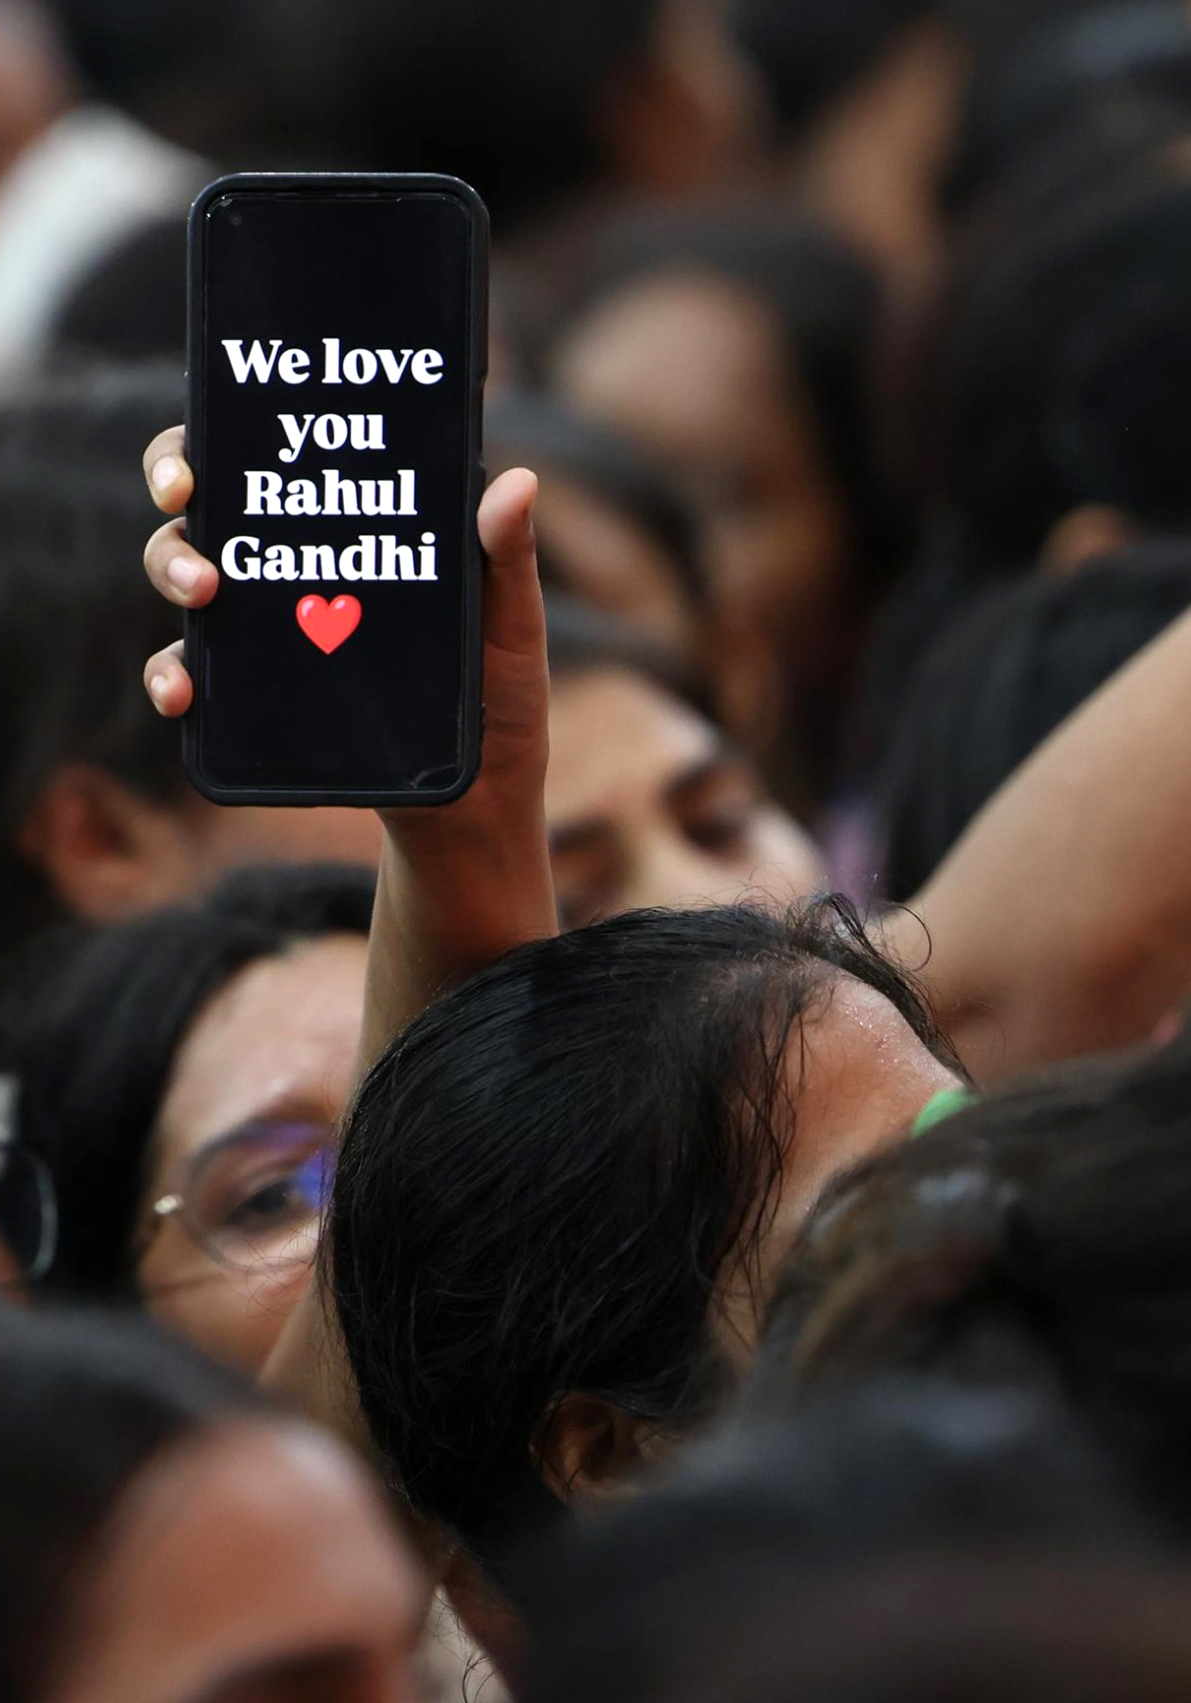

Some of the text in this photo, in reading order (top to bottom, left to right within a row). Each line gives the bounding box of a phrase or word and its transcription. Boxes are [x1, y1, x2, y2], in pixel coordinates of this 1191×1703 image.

[221, 338, 443, 384] We love
[277, 414, 385, 462] you
[244, 470, 417, 515] Rahul
[221, 532, 438, 581] Gandhi
